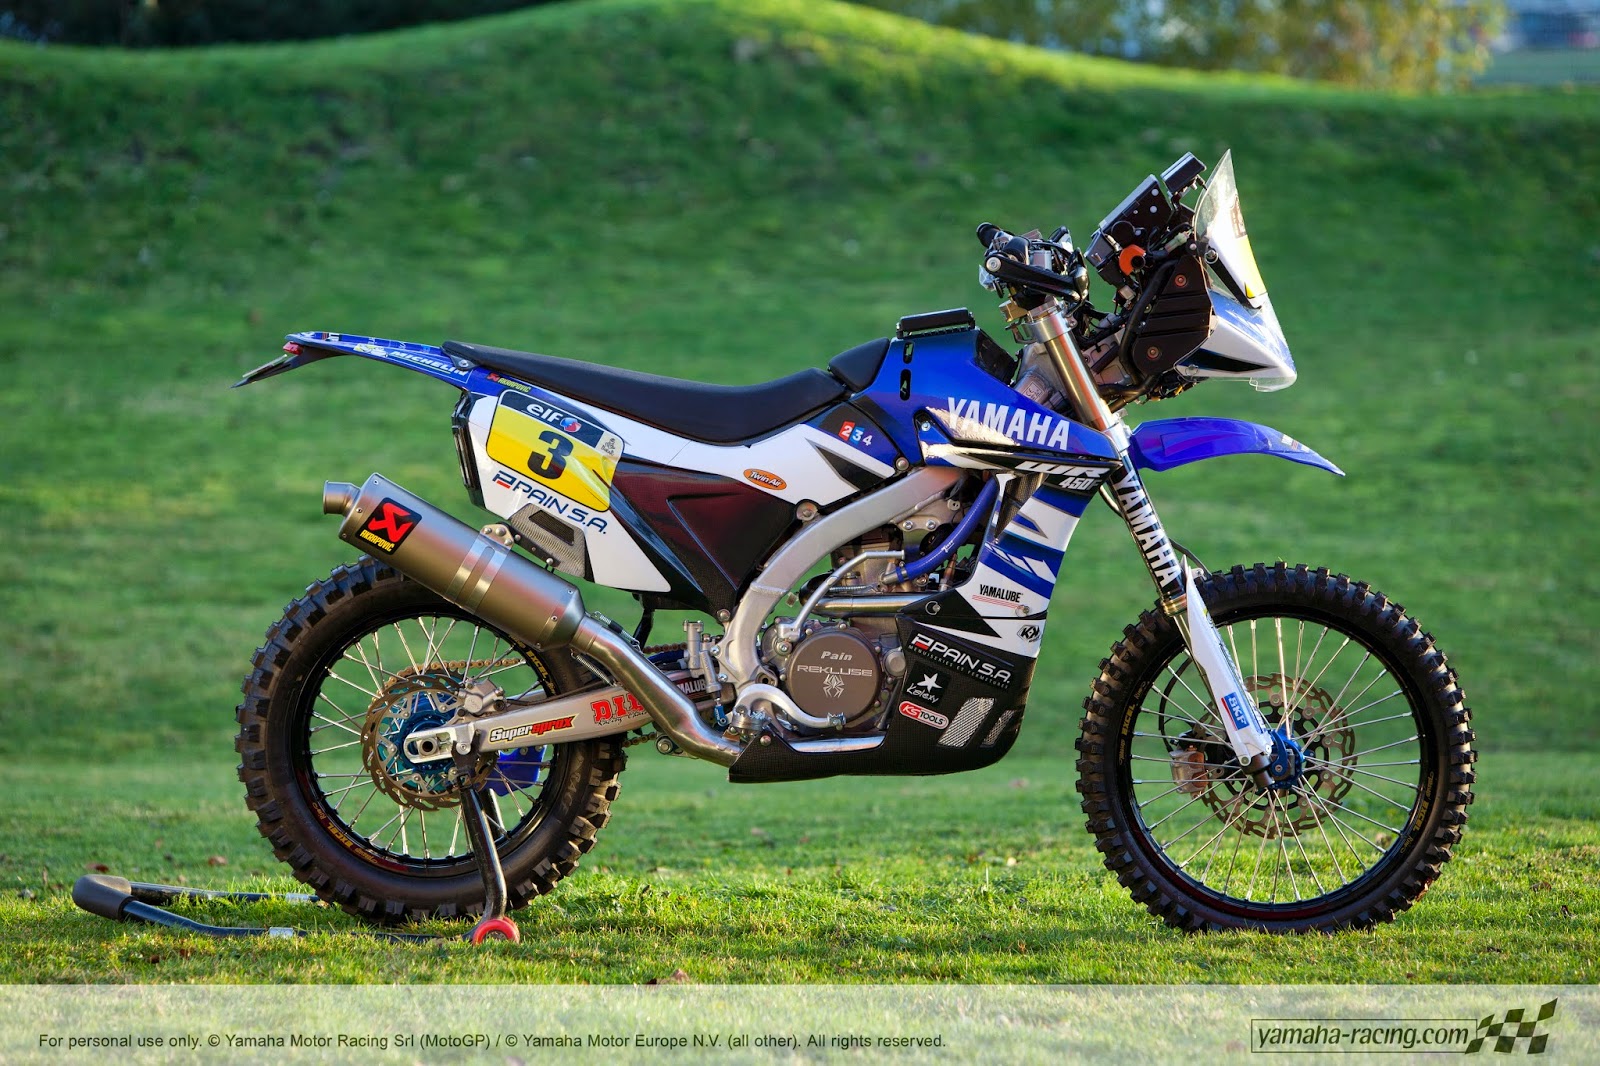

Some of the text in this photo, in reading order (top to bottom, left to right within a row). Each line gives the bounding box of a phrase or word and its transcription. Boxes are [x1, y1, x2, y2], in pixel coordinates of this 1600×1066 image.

[389, 351, 469, 377] MICHELIN
[526, 403, 562, 423] elf
[947, 396, 1070, 451] YAMAHA
[527, 430, 574, 480] 3
[750, 471, 782, 488] Twin Air
[1058, 476, 1103, 491] 450F
[513, 480, 608, 534] PAIN S.A.
[1113, 468, 1182, 588] YAMAHA
[979, 583, 1021, 603] YAMALUBE
[526, 650, 549, 679] EXCEL
[820, 650, 853, 661] Pain
[929, 641, 1012, 684] PAIN S.A.
[797, 664, 873, 677] REKLUSE
[902, 704, 945, 726] KS TOOLS
[1121, 704, 1136, 736] EXCEL
[490, 716, 574, 742] Supersprox
[1412, 801, 1430, 832] EXCEL
[327, 822, 354, 848] EXCEL
